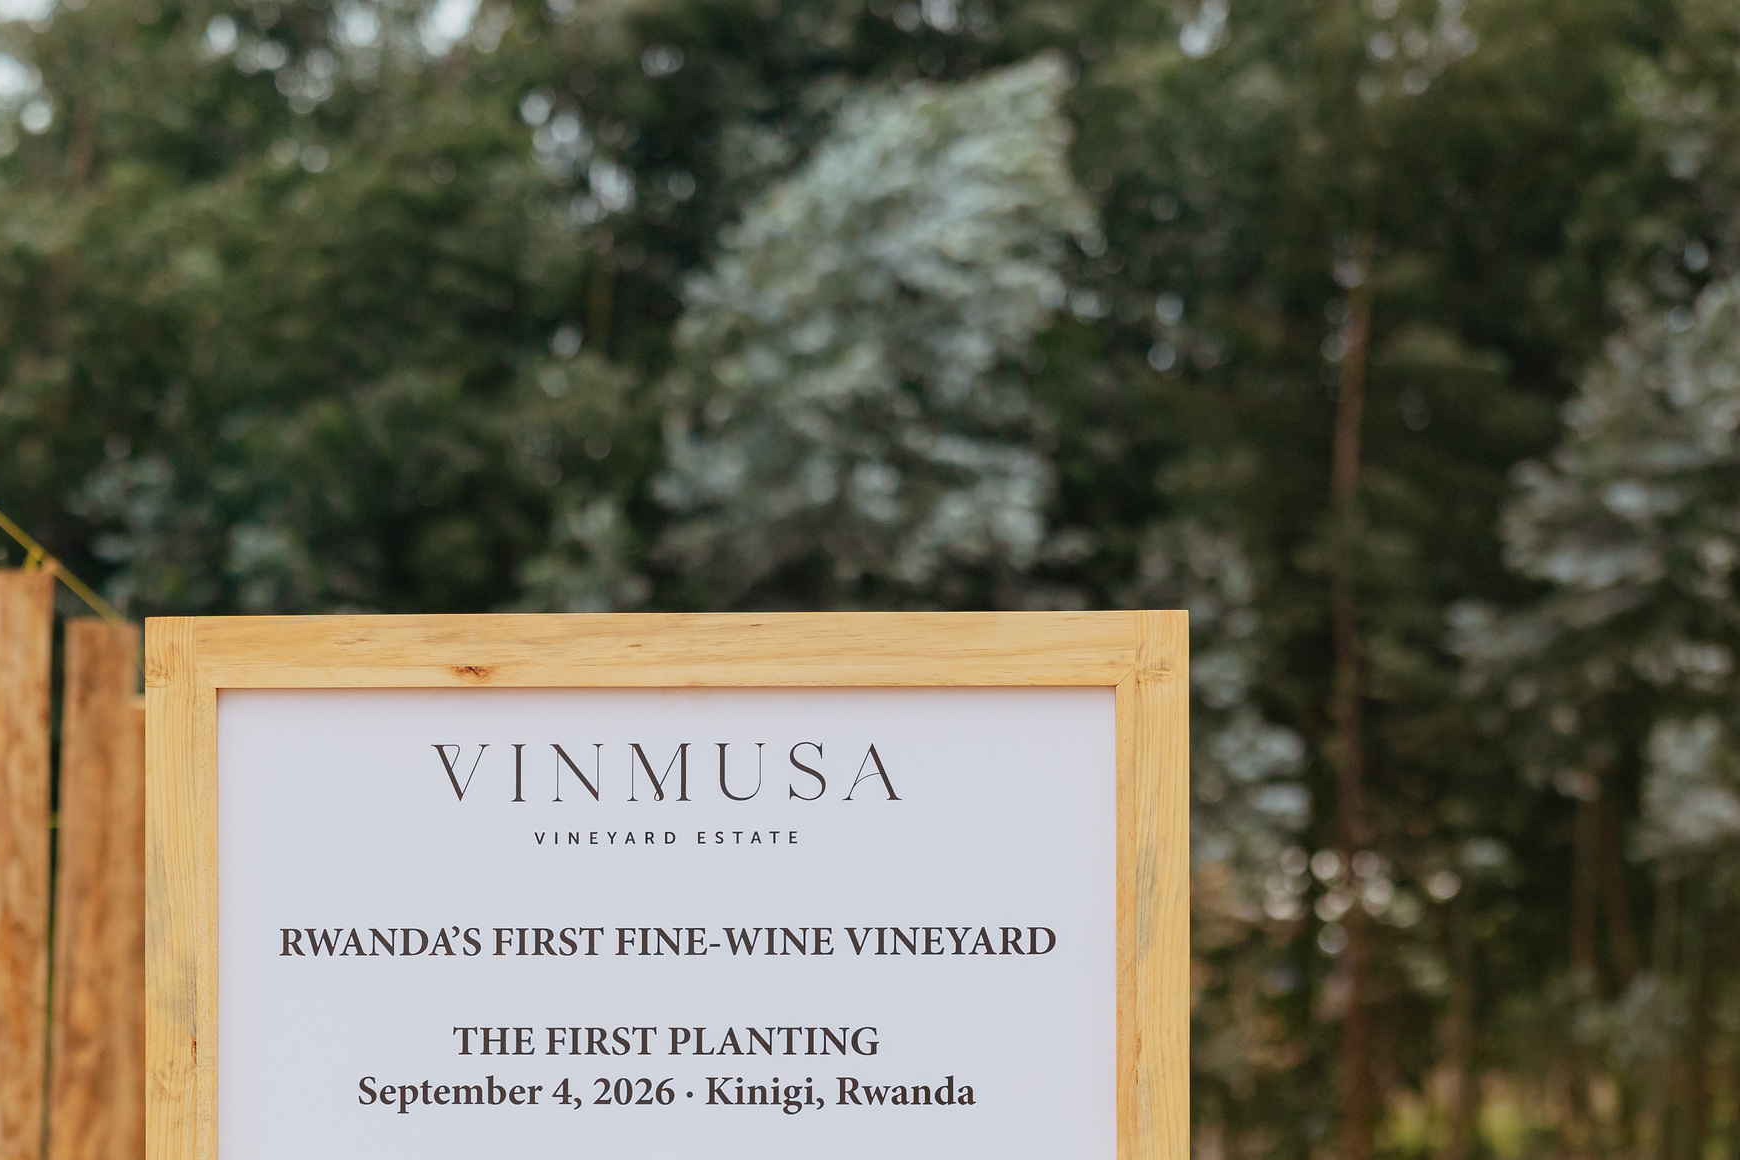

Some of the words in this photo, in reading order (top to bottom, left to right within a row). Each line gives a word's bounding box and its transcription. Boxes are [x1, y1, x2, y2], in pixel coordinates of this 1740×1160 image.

[430, 741, 903, 803] VINMUSA
[533, 831, 677, 845] VINEYARD
[697, 830, 798, 845] ESTATE
[278, 925, 482, 957] RWANDA’S
[492, 926, 605, 957] FIRST
[614, 927, 835, 956] FINE-WINE
[843, 926, 1057, 956] VINEYARD
[452, 1025, 536, 1056] THE
[545, 1025, 658, 1056] FIRST
[667, 1025, 880, 1056] PLANTING
[358, 1074, 544, 1115] September
[551, 1077, 583, 1111] 4,
[592, 1077, 676, 1106] 2026
[704, 1076, 825, 1116] Kinigi,
[835, 1074, 977, 1106] Rwanda
